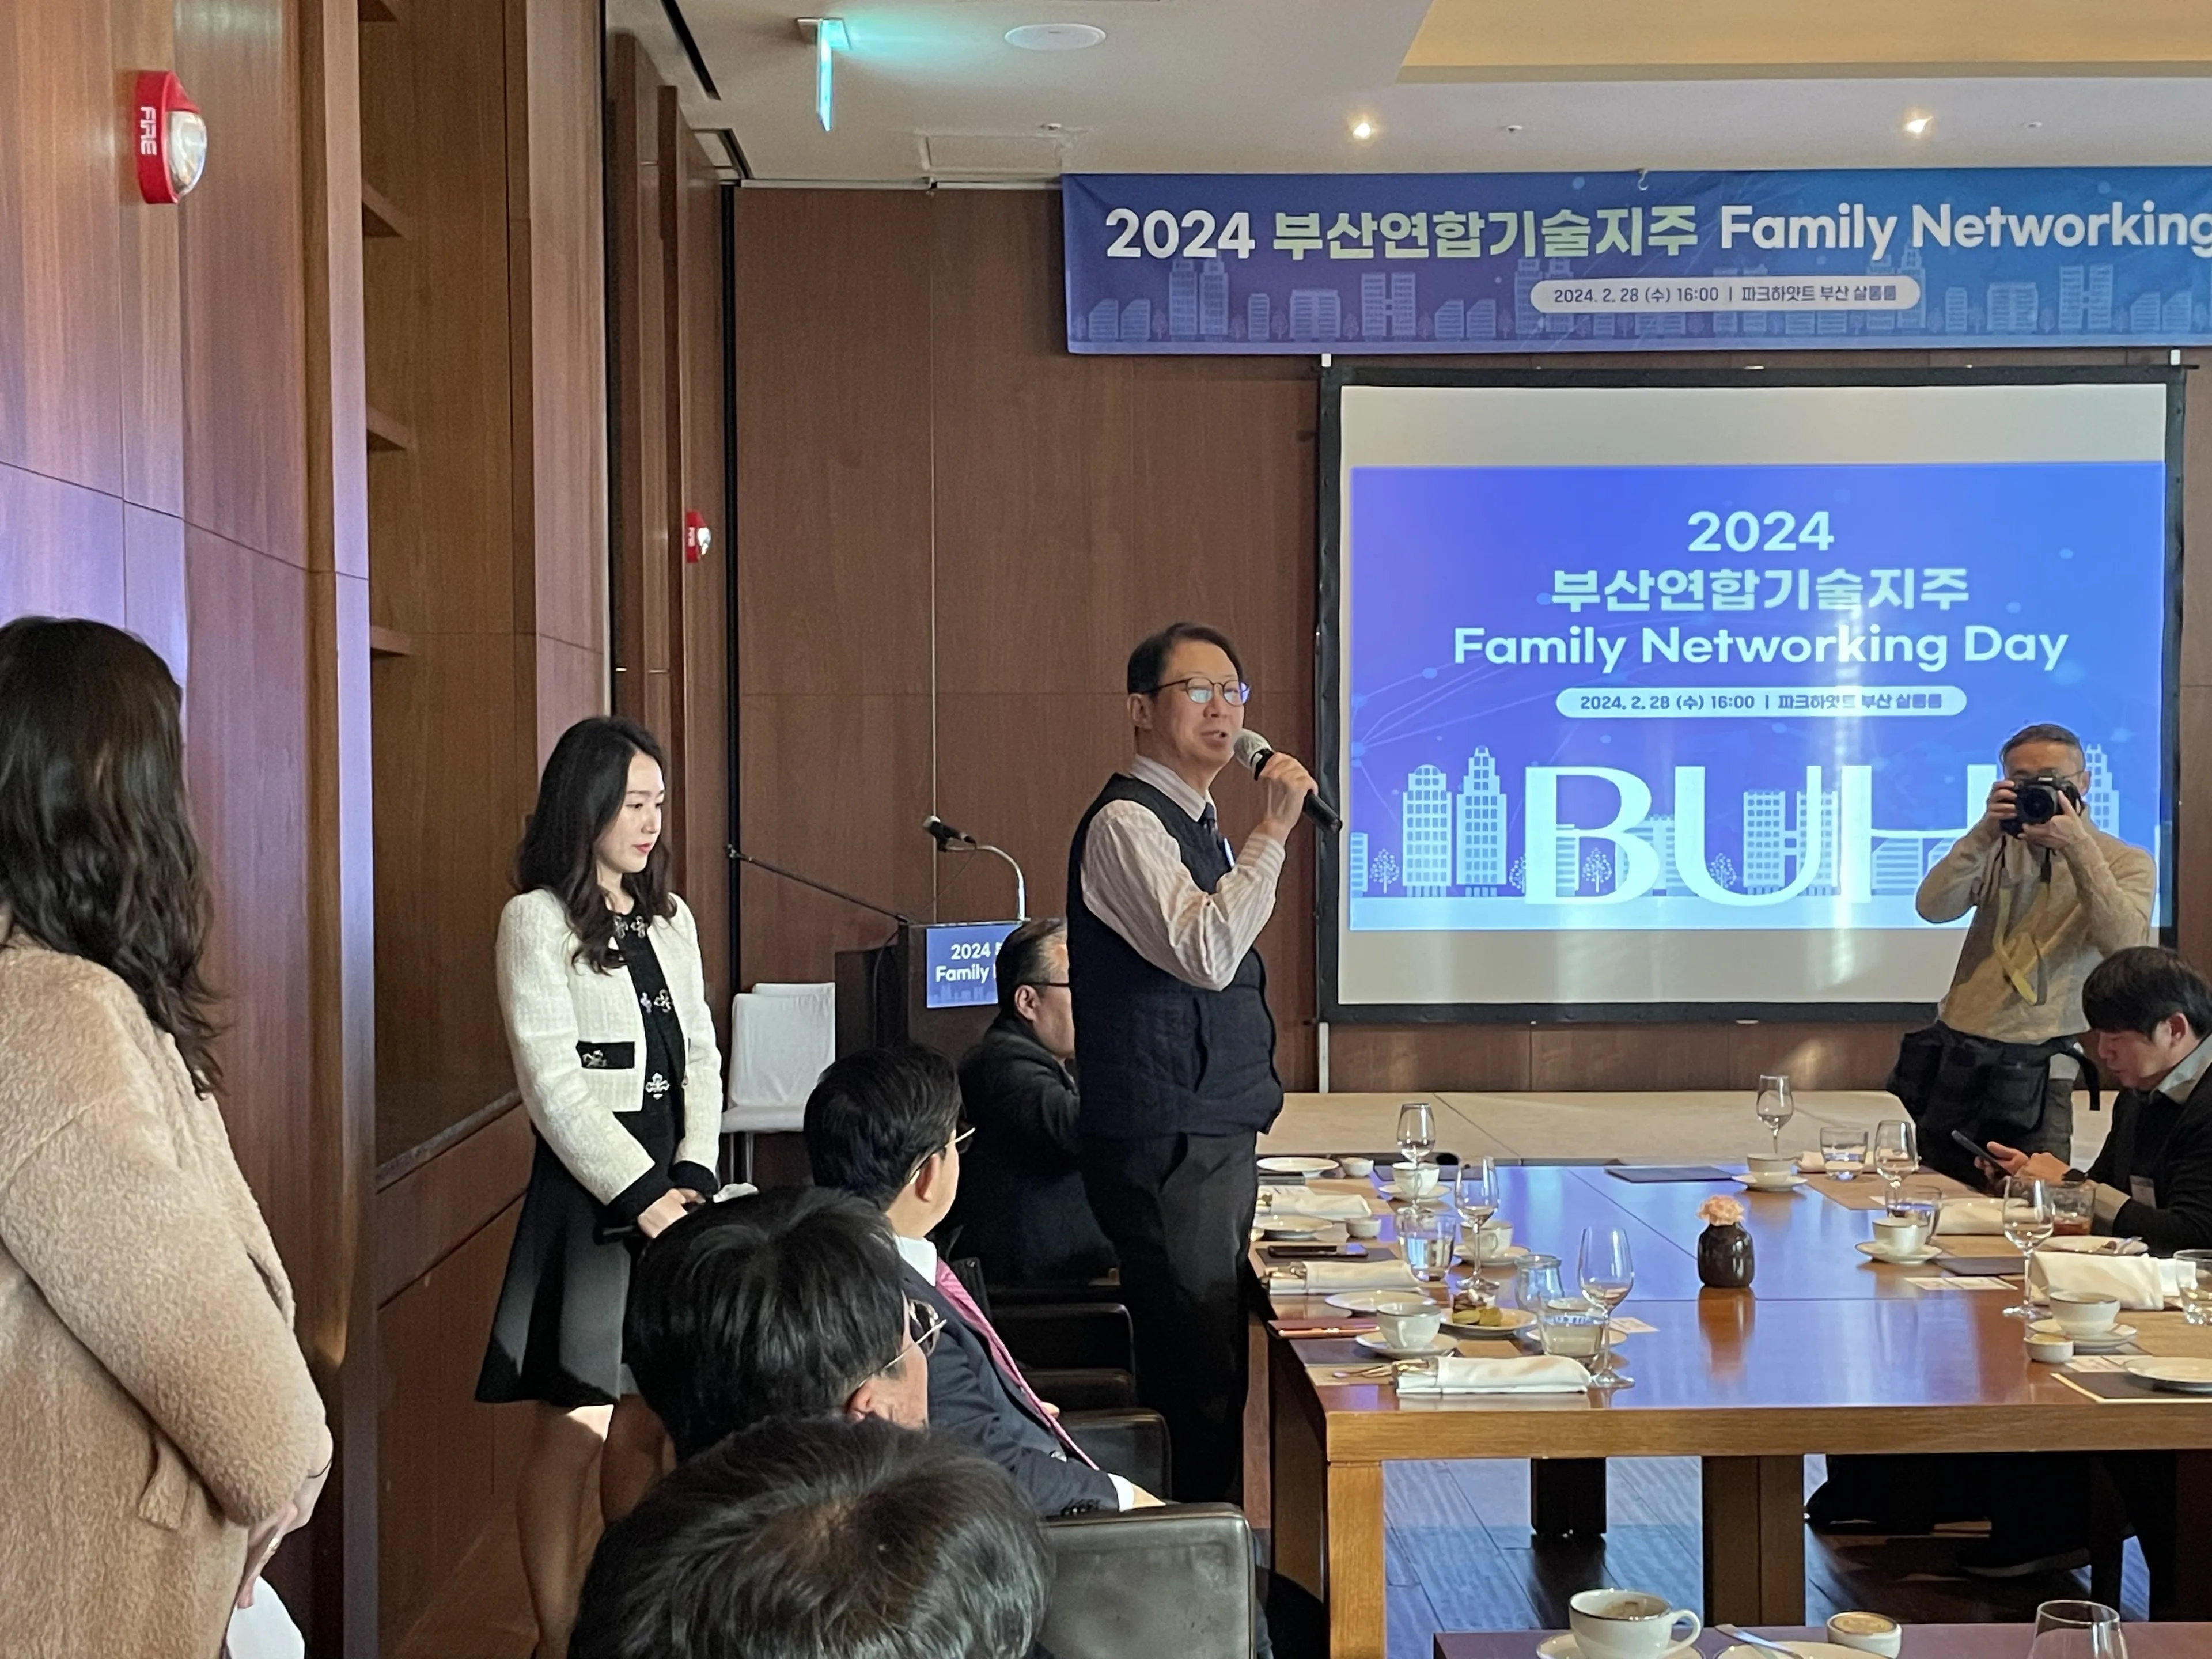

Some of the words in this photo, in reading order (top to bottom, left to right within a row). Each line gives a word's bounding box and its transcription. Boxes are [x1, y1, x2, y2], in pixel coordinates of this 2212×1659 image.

[140, 107, 157, 156] FIRE
[1105, 208, 1255, 259] 2024
[1273, 204, 1698, 260] 부산연합기술지주
[1721, 202, 1898, 260] Family
[1912, 200, 2212, 258] Networking
[1554, 289, 1598, 302] 2024.
[1620, 287, 1639, 302] 28
[1645, 286, 1671, 303] (수)
[1677, 286, 1719, 302] 16:00
[1820, 285, 1849, 301] 부산
[1688, 510, 1835, 551] 2024
[1551, 568, 1969, 612] 부산연합기술지주
[1455, 626, 1627, 673] Family
[1642, 624, 1948, 672] Networking
[1965, 626, 2069, 671] Day
[1581, 695, 1627, 709] 2024.
[1650, 695, 1670, 709] 28
[1676, 694, 1705, 710] (수)
[1711, 695, 1755, 709] 16:00
[1525, 764, 1997, 906] BUH
[950, 942, 991, 960] 2024
[935, 963, 990, 984] Family
